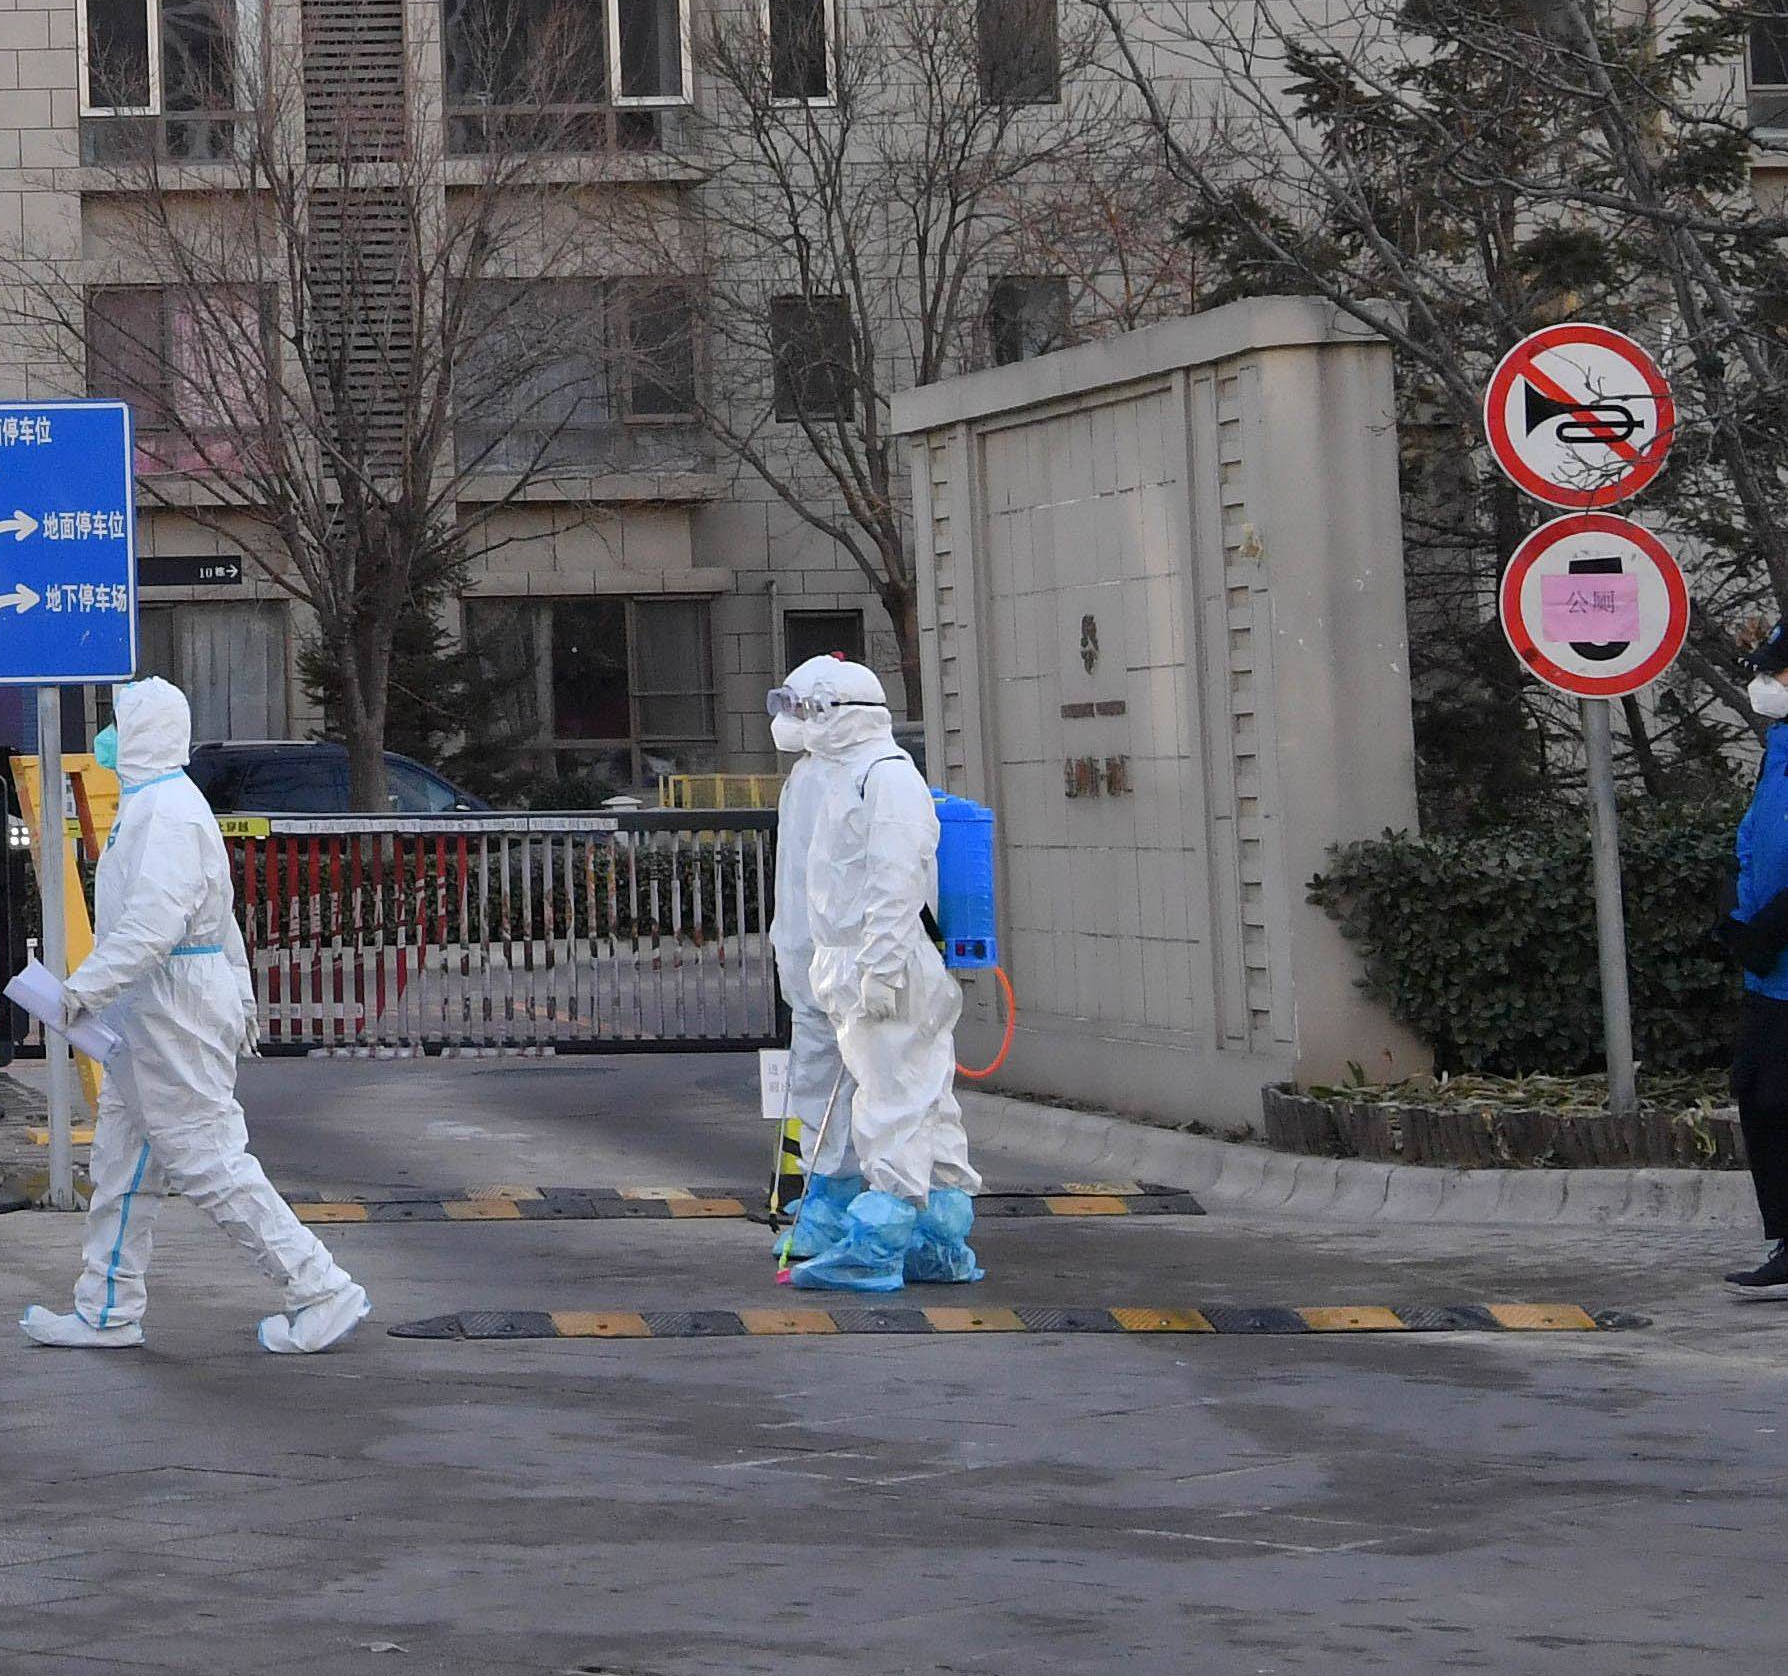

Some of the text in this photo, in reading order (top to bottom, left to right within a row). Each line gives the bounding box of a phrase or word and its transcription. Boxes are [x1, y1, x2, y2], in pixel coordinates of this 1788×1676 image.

[43, 511, 125, 540] 地面停车位
[45, 583, 127, 613] 地下停车场
[1567, 590, 1616, 614] 公厕
